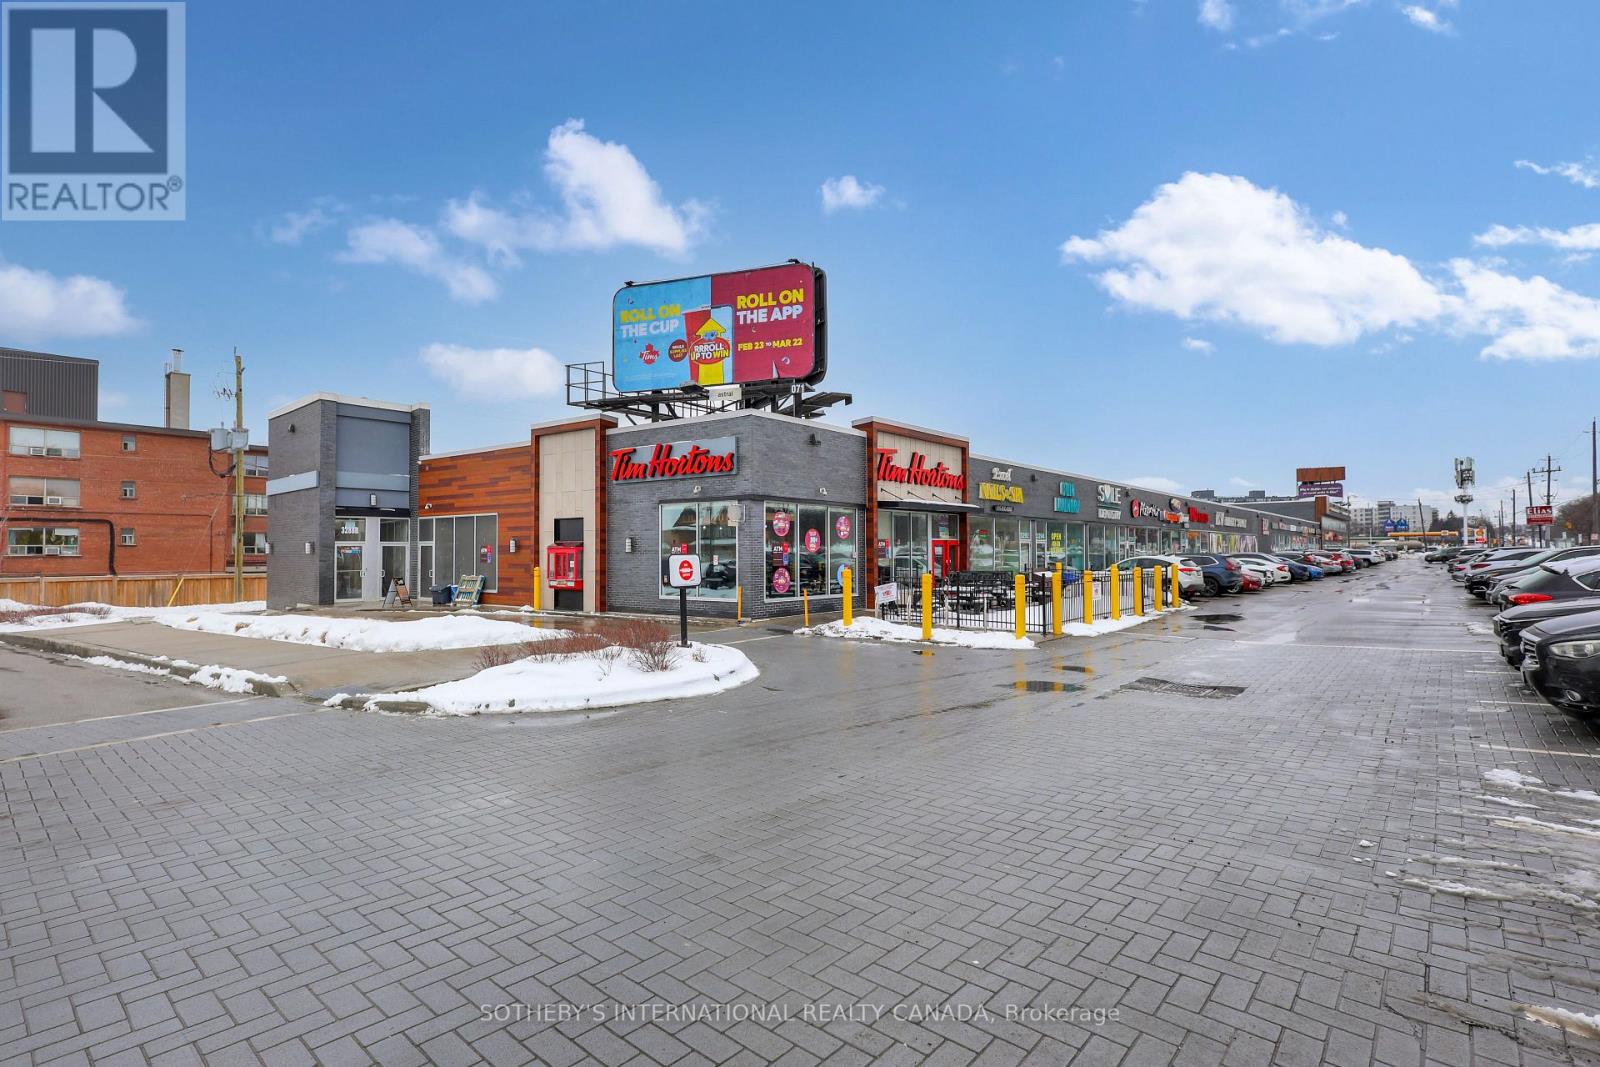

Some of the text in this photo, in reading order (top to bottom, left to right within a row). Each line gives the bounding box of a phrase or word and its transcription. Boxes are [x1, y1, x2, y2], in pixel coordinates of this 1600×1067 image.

[736, 288, 804, 309] ROLL ON
[620, 304, 681, 323] ROLL ON
[736, 305, 803, 324] THE APP
[621, 319, 679, 337] THE CUP
[738, 343, 753, 351] FEB
[754, 341, 764, 350] 23
[772, 339, 791, 348] MAR
[792, 337, 803, 346] 22
[690, 349, 729, 361] UP TO WIN
[608, 443, 735, 481] Tim Hortons
[876, 447, 966, 490] Tim Hortons
